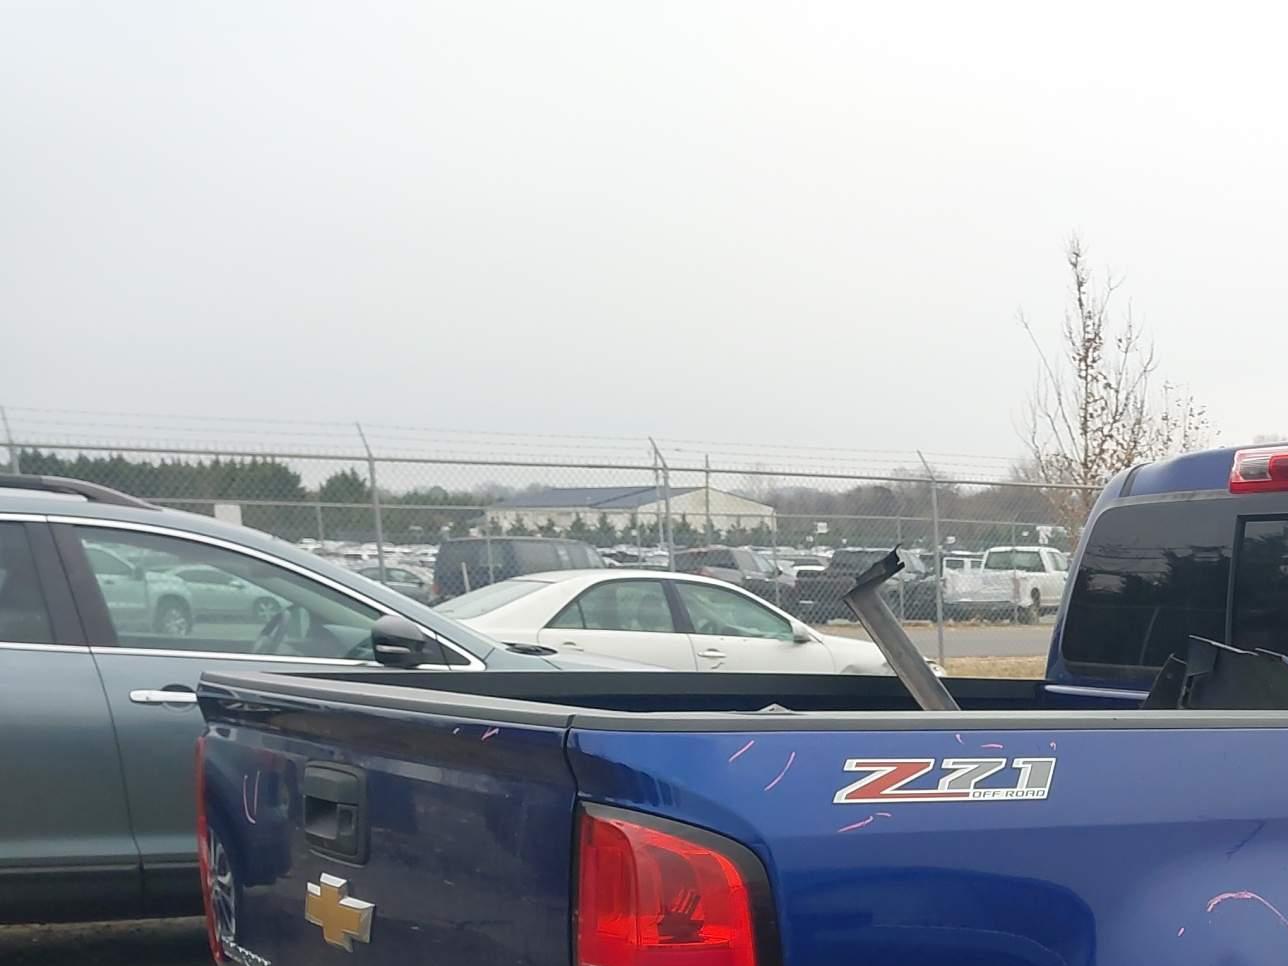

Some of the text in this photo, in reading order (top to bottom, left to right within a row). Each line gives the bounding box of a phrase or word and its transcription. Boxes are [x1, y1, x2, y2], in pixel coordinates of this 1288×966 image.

[833, 757, 1056, 804] Z71
[972, 788, 1047, 799] OFF ROAD
